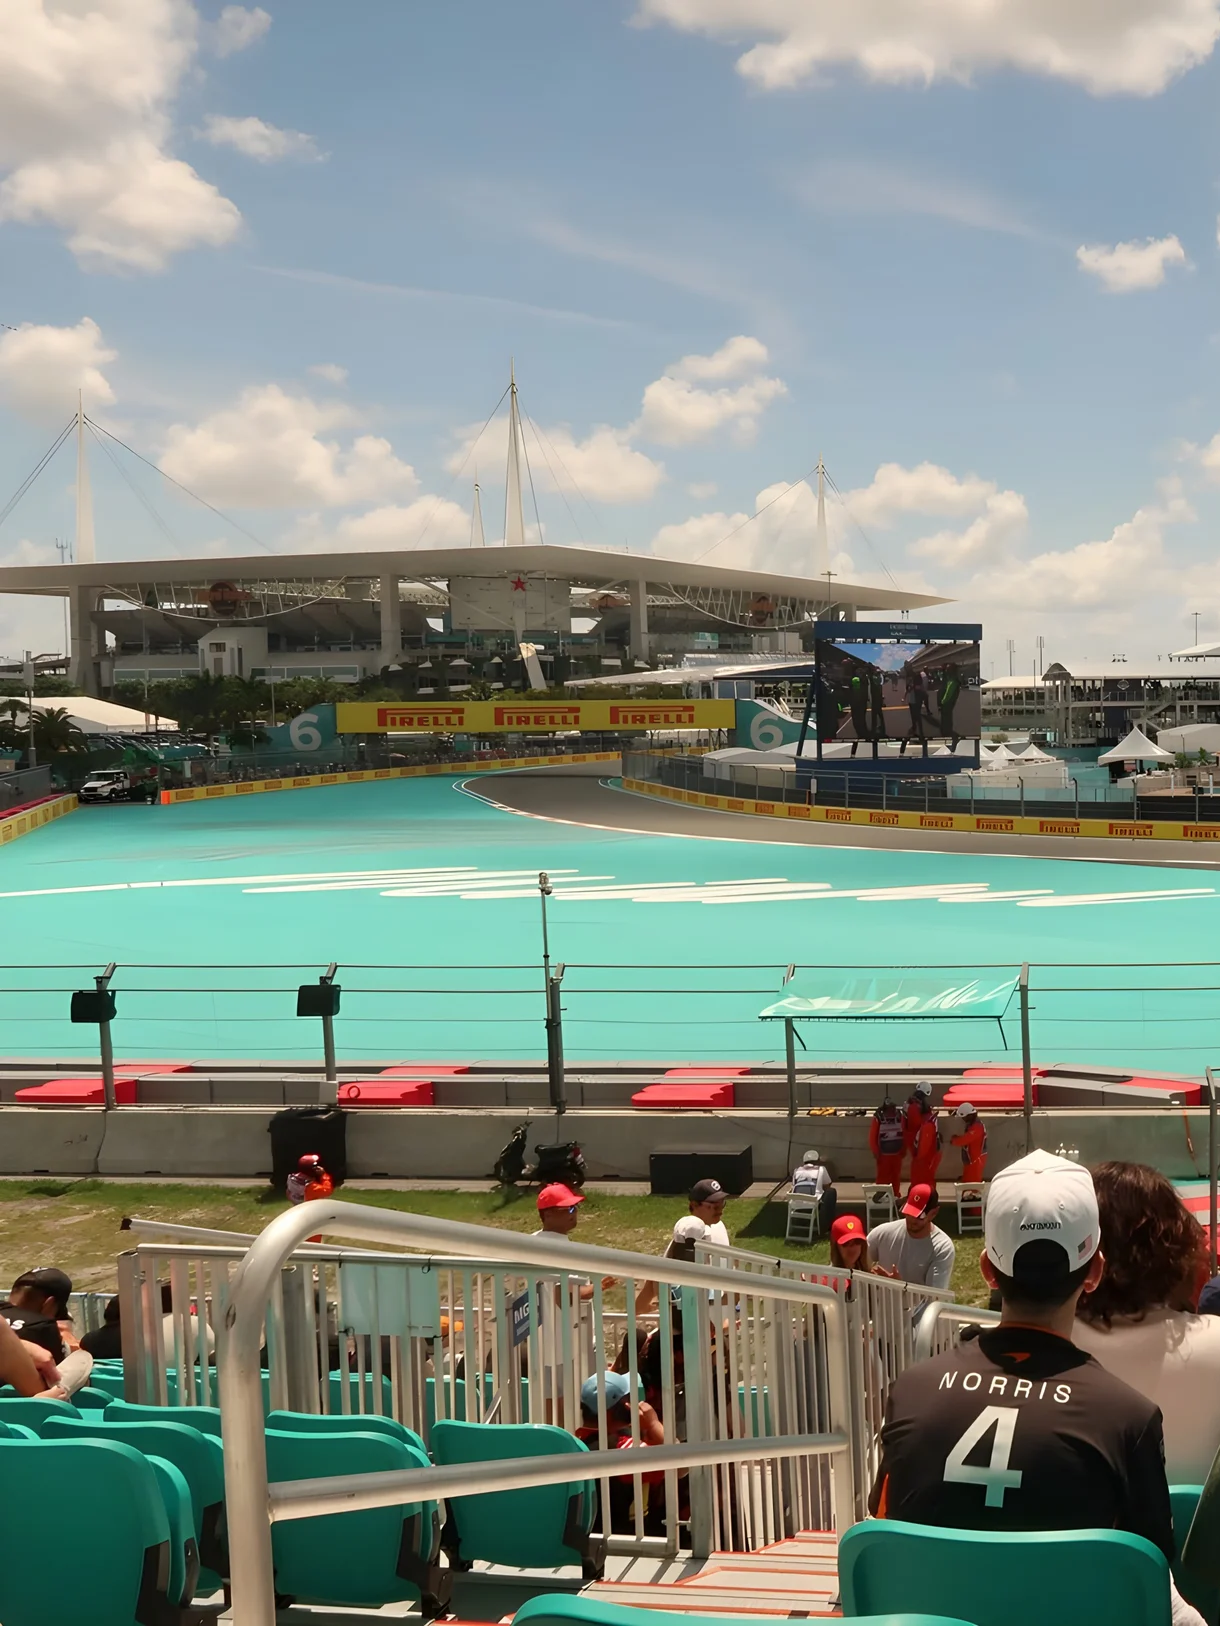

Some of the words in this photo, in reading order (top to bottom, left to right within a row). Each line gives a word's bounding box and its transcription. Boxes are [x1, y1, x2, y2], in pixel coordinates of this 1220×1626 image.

[377, 708, 464, 726] PIRELLI
[494, 706, 581, 725] PIRELLI
[609, 705, 694, 724] PIRELLI
[750, 709, 783, 751] 6
[290, 712, 321, 750] 6
[939, 1371, 1072, 1403] NORRIS
[943, 1405, 1023, 1508] 4
